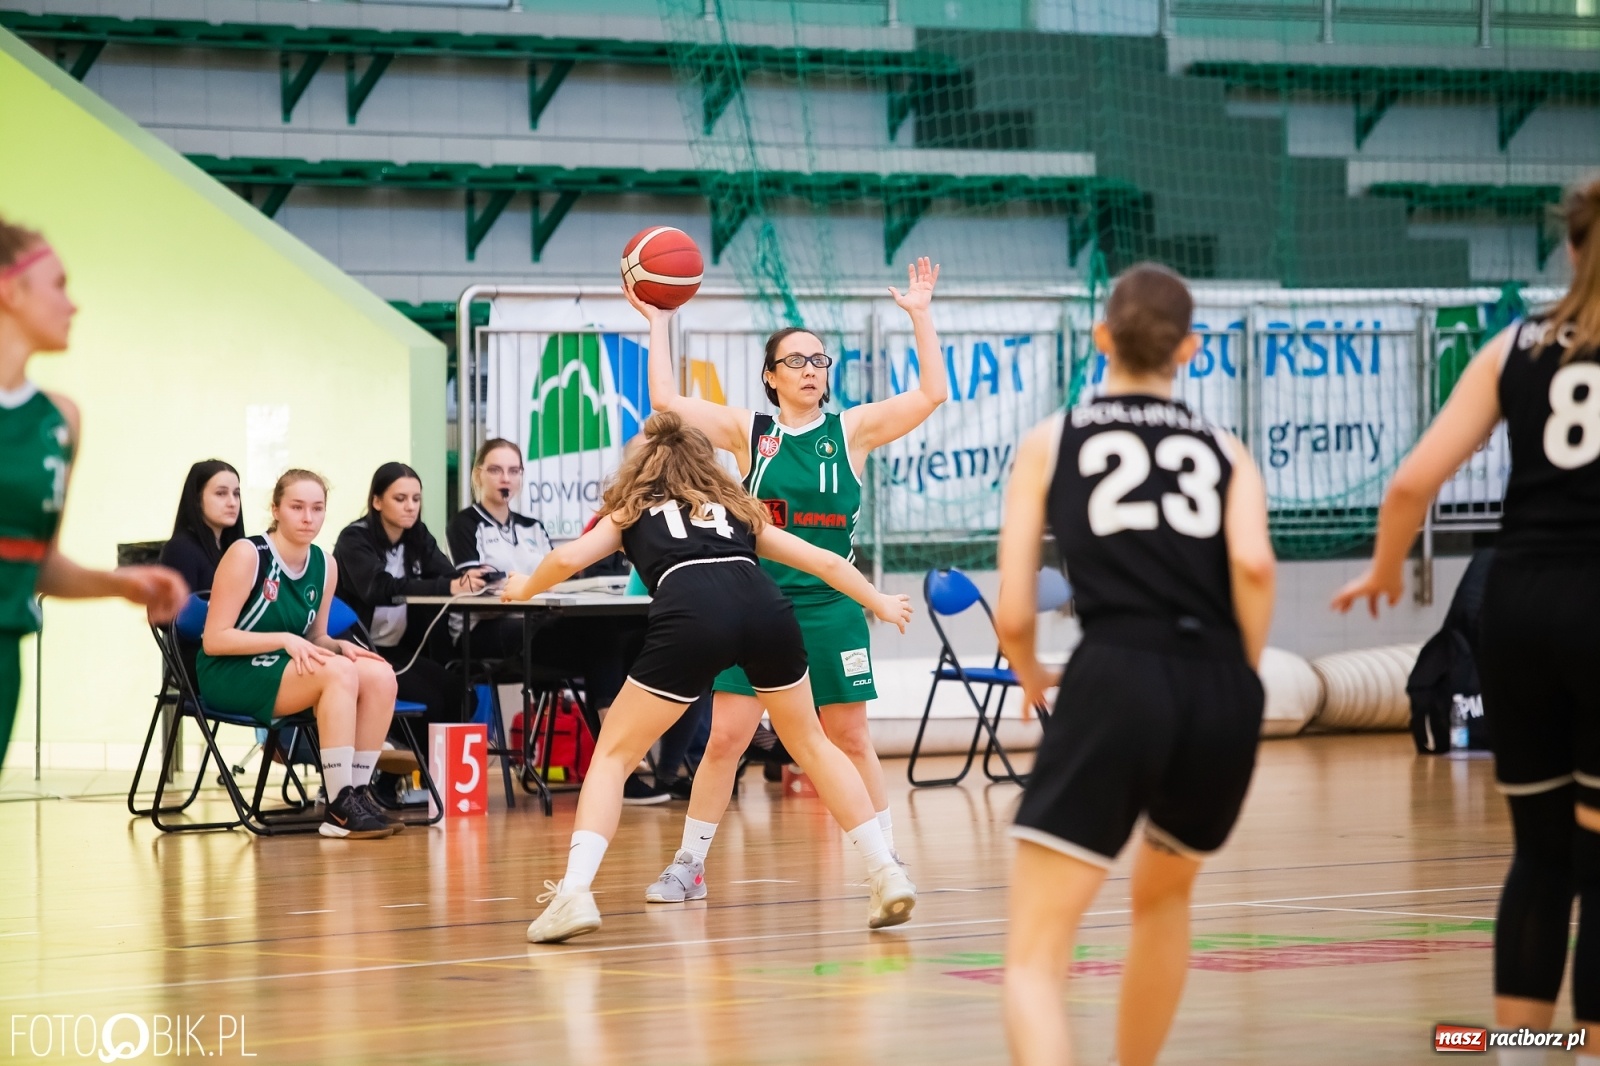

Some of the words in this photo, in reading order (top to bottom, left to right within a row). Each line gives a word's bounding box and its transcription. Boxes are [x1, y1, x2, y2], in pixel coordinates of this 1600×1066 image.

[1543, 361, 1600, 470] 8
[1269, 421, 1384, 468] gramy
[529, 470, 607, 513] powia
[819, 461, 838, 493] 11
[1078, 430, 1221, 539] 23
[649, 500, 734, 539] 14
[793, 511, 847, 528] KAMAN
[454, 733, 482, 794] 5
